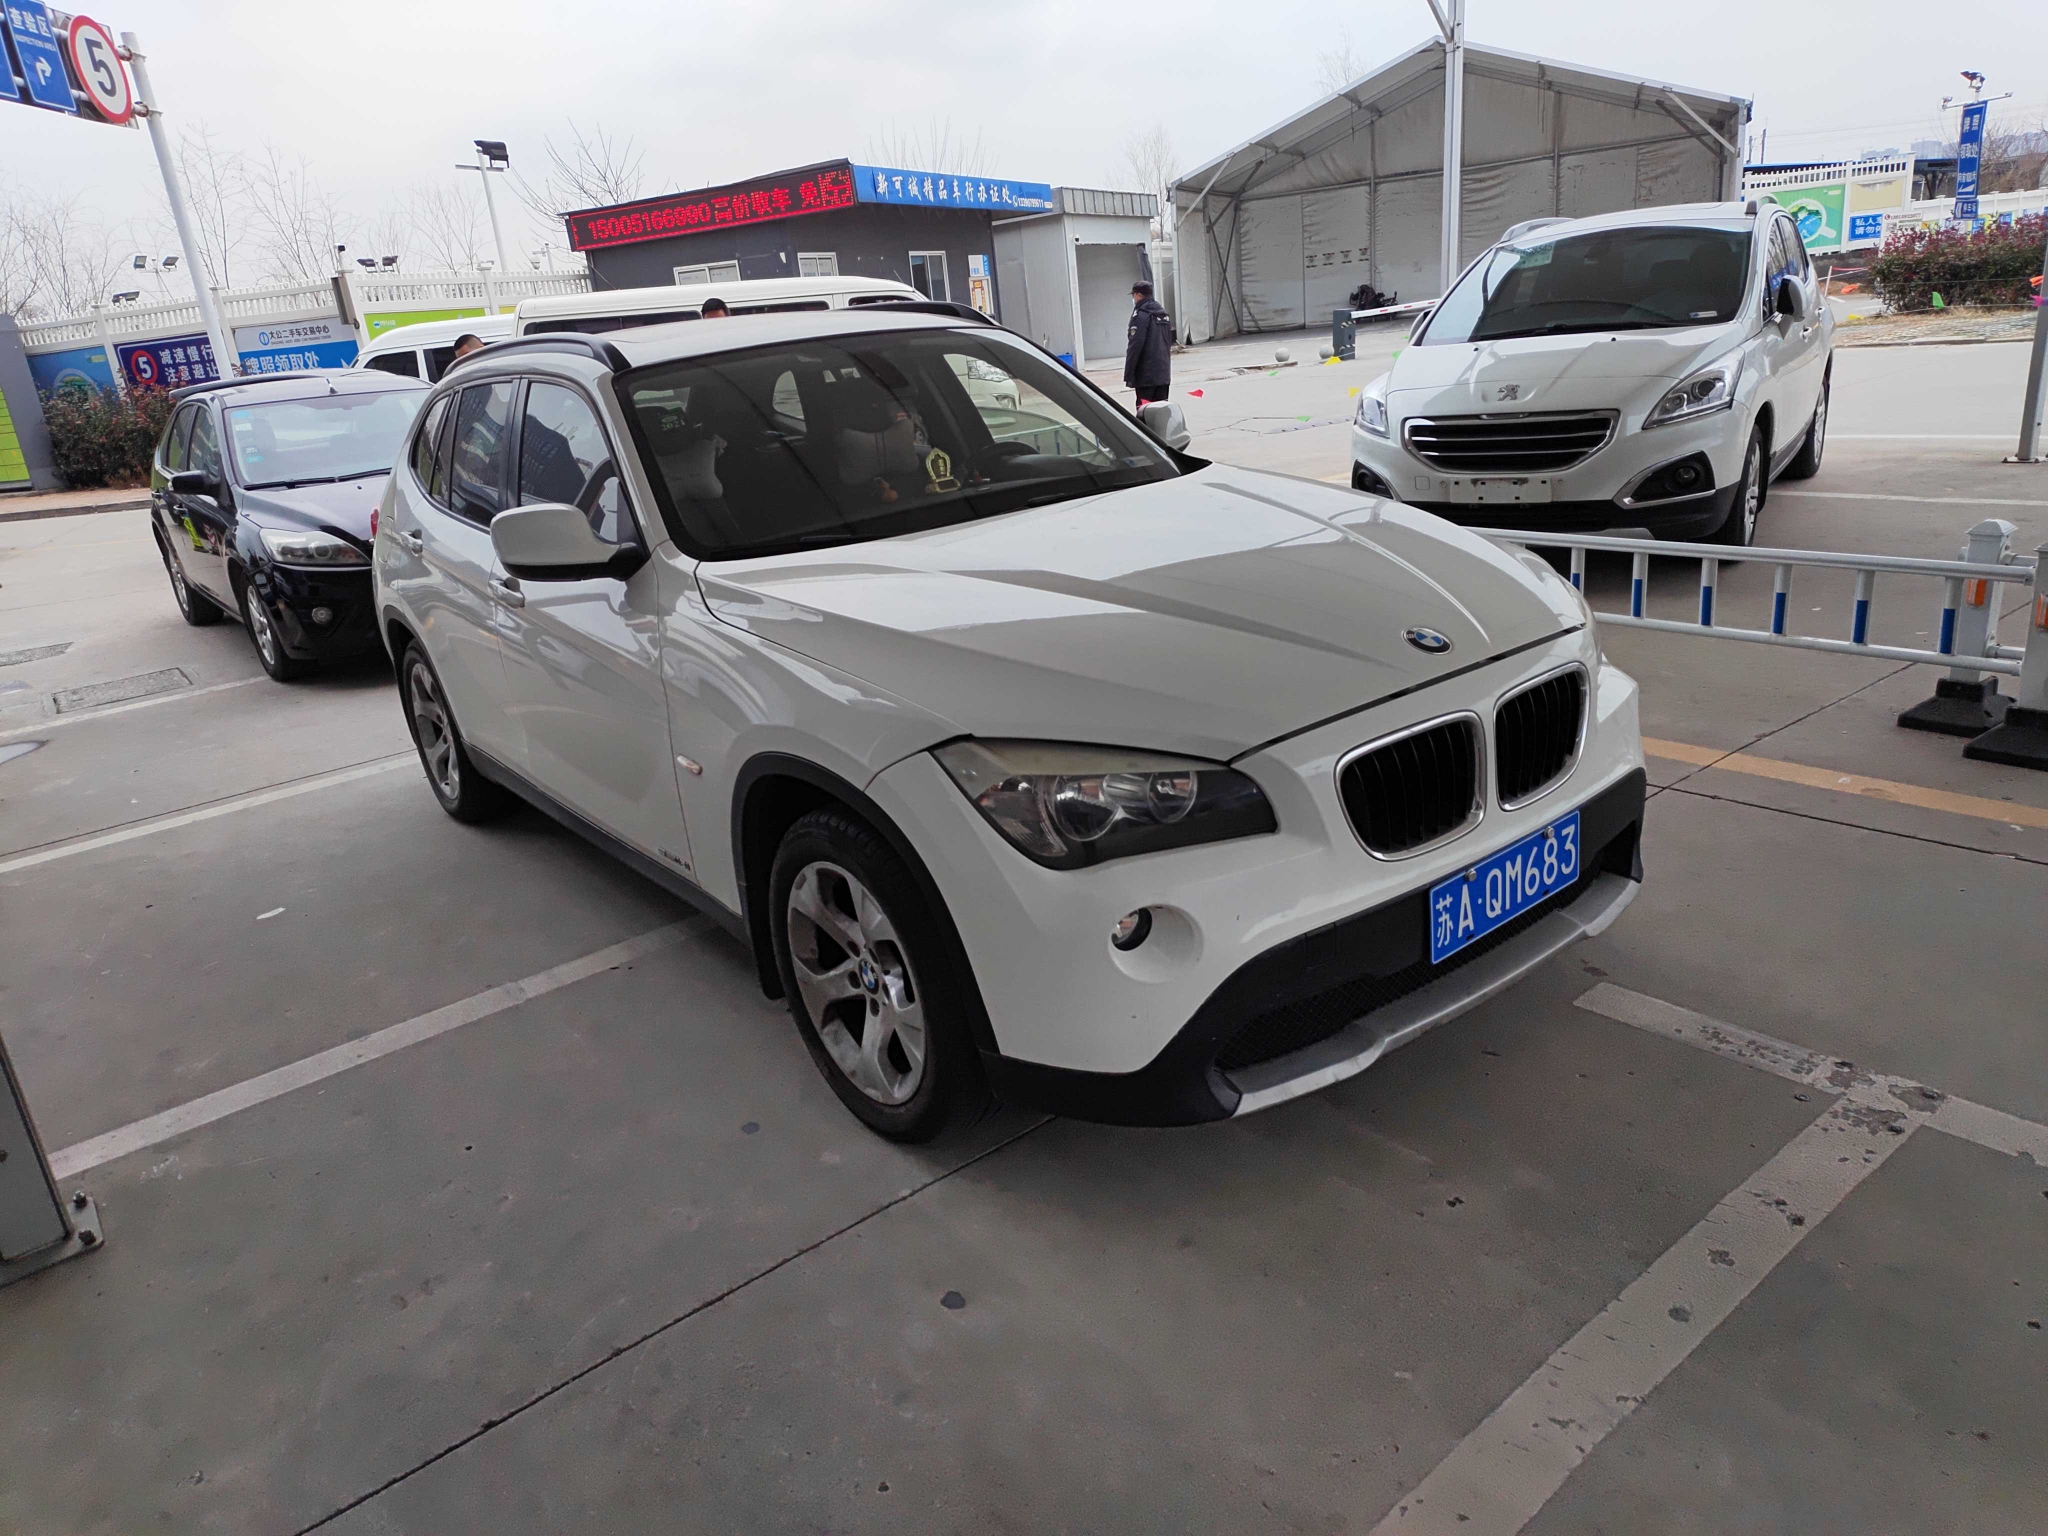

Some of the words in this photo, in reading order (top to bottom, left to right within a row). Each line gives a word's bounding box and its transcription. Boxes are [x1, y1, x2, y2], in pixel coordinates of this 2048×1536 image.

[9, 7, 52, 38] 查验区
[84, 37, 117, 97] 5
[269, 324, 330, 340] 大公二手车交易中心
[159, 344, 214, 365] 减速慢行
[246, 350, 320, 375] 牌照领取处
[137, 356, 152, 379] 5
[164, 361, 220, 383] 注意避让
